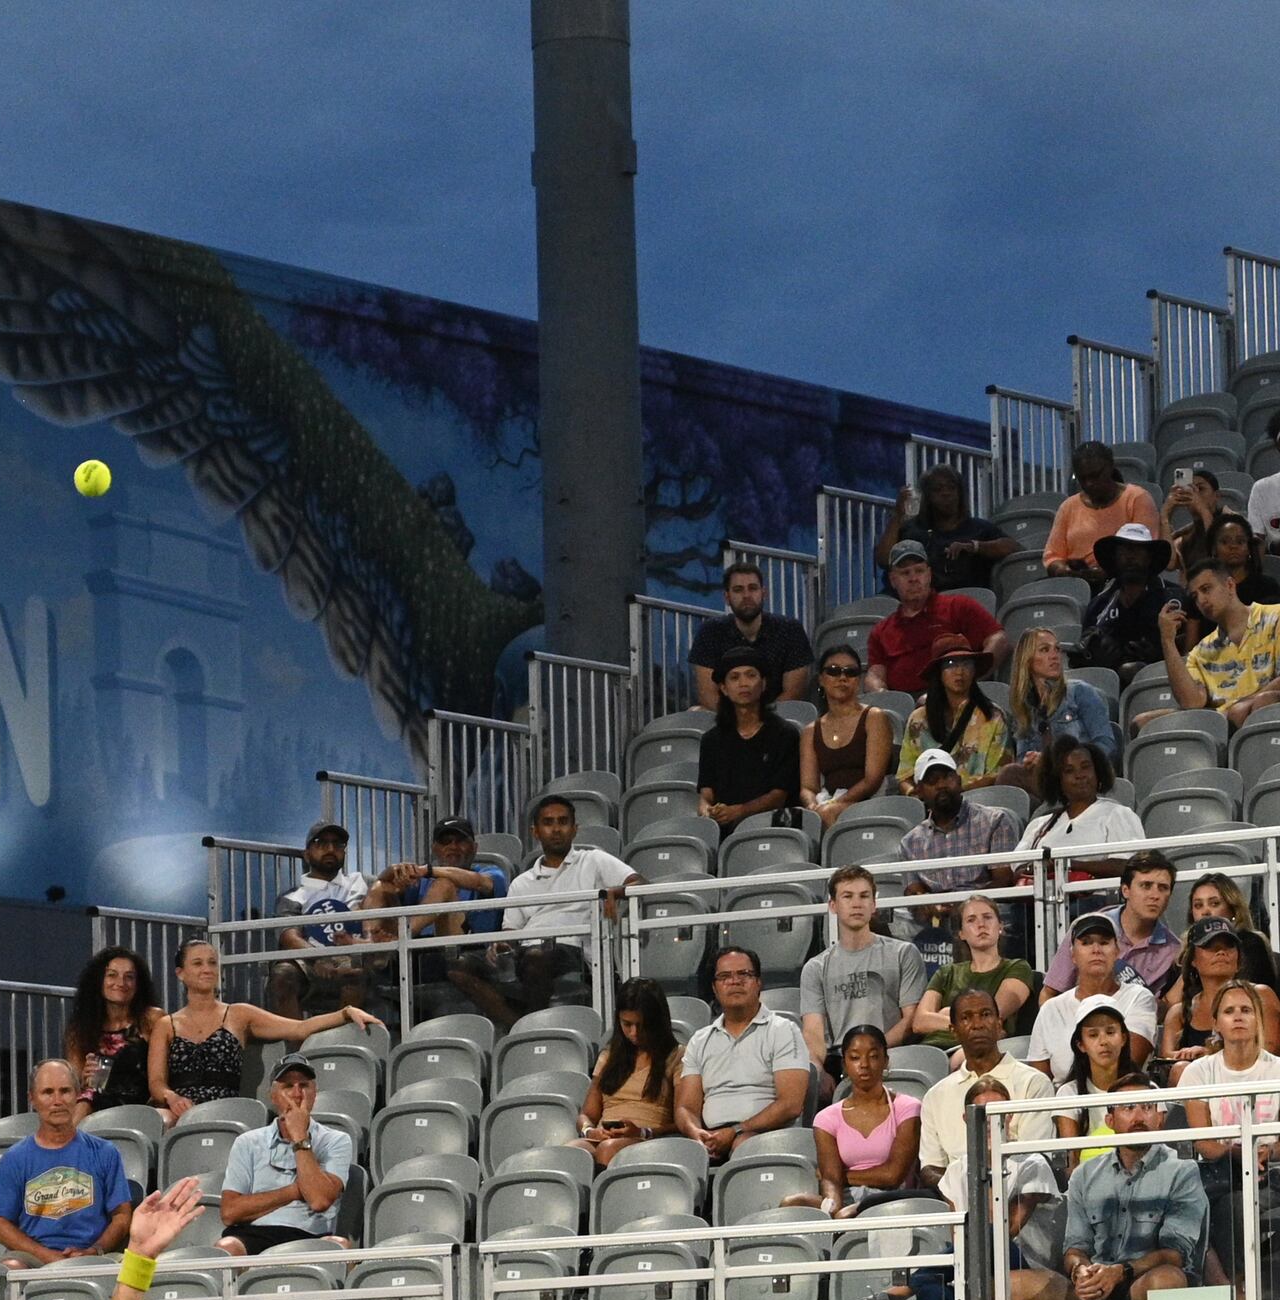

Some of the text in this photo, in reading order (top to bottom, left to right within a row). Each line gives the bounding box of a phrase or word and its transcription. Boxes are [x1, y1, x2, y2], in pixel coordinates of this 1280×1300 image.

[1203, 921, 1230, 933] USA
[847, 971, 867, 982] THE
[834, 980, 868, 994] NORTH
[843, 988, 868, 1000] FACE
[33, 1189, 60, 1202] Grand
